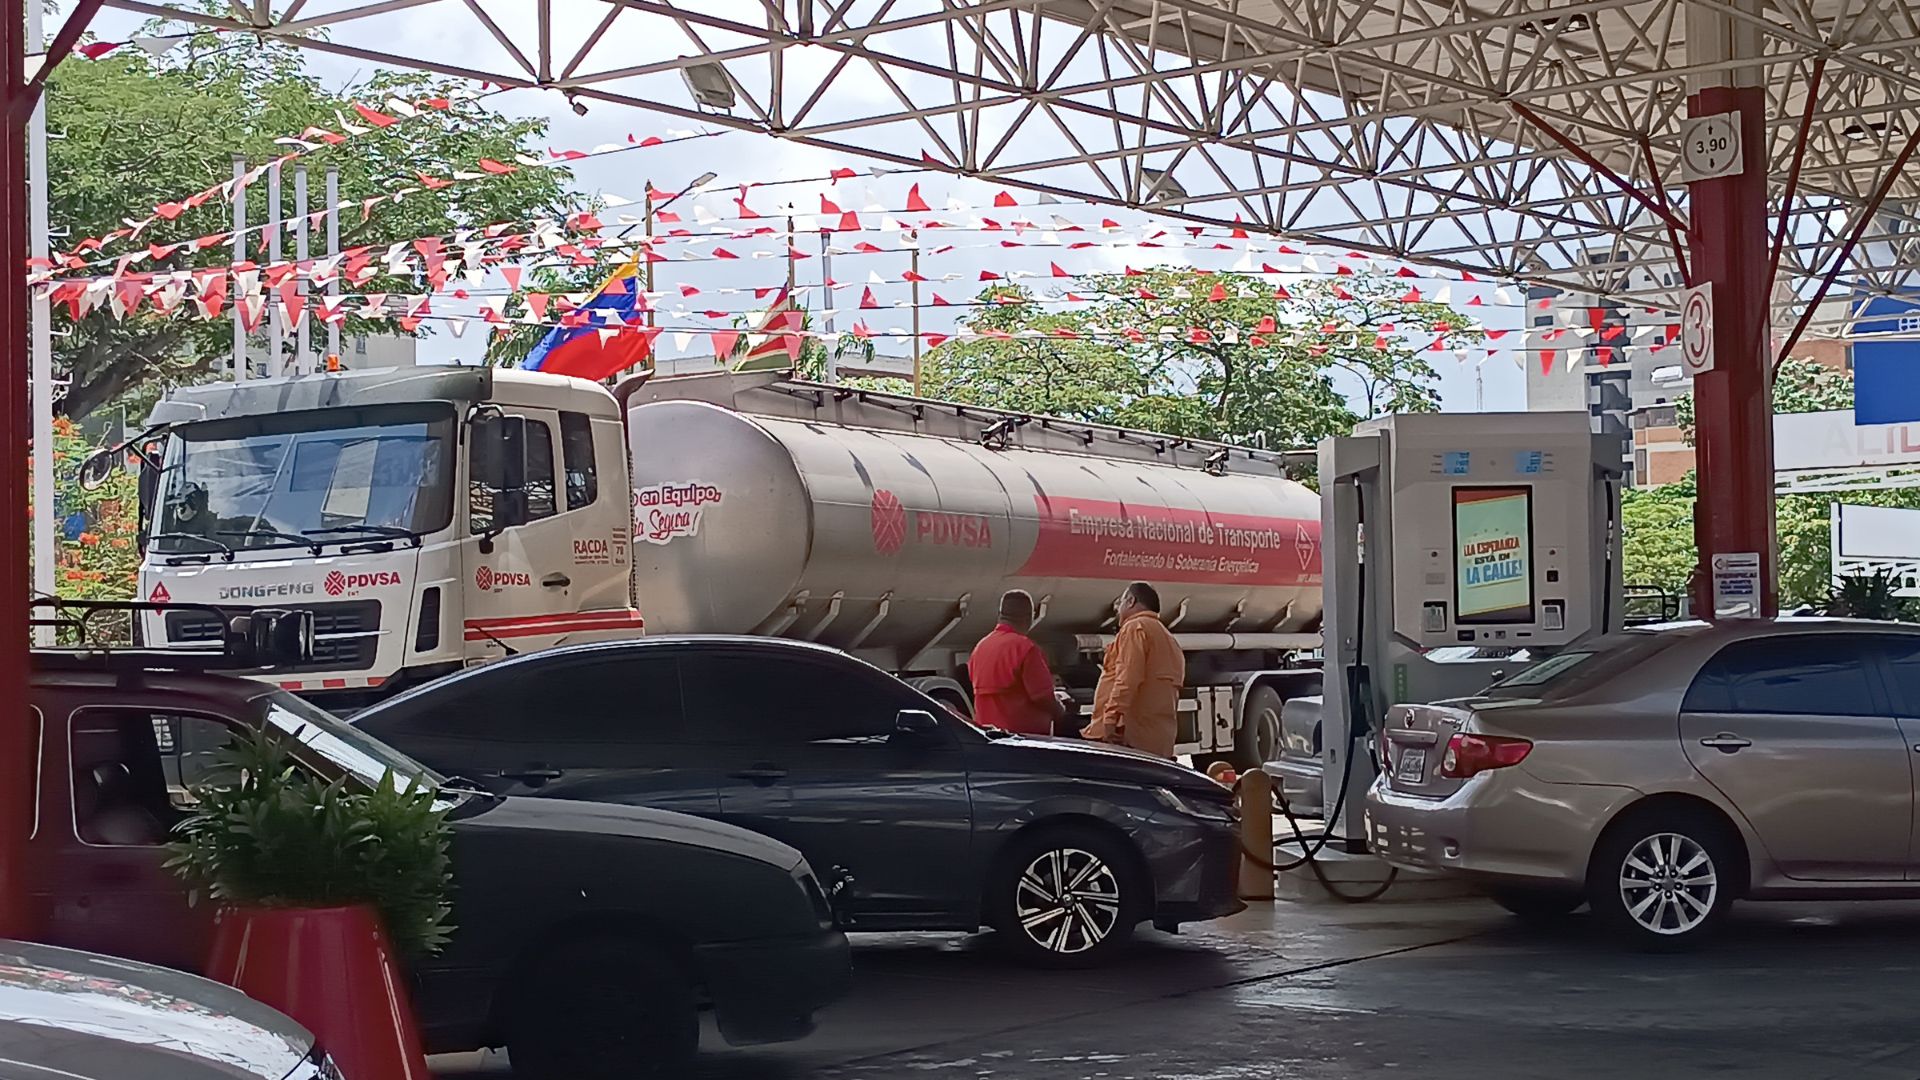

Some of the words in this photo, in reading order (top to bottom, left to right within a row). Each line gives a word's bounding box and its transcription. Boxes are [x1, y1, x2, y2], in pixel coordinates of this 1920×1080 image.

[1690, 300, 1704, 357] 3
[641, 491, 660, 507] en
[662, 484, 721, 507] Equipo,
[915, 511, 993, 548] PDVSA
[1069, 508, 1134, 542] Empresa
[1137, 515, 1195, 543] Nacional
[1199, 521, 1214, 545] de
[1216, 522, 1281, 554] Transporte
[574, 540, 608, 554] RACDA
[1477, 536, 1520, 554] ESPERANZA
[1103, 548, 1165, 569] Fortaleciendo
[1166, 553, 1174, 569] la
[1175, 553, 1217, 572] Soberanía
[1218, 556, 1260, 576] Energética
[1498, 552, 1510, 561] EN
[347, 572, 401, 588] PDVSA
[494, 572, 531, 586] PDVSA
[1466, 566, 1480, 585] LA
[1483, 559, 1523, 582] CALLE!
[219, 582, 314, 599] DONGFENG
